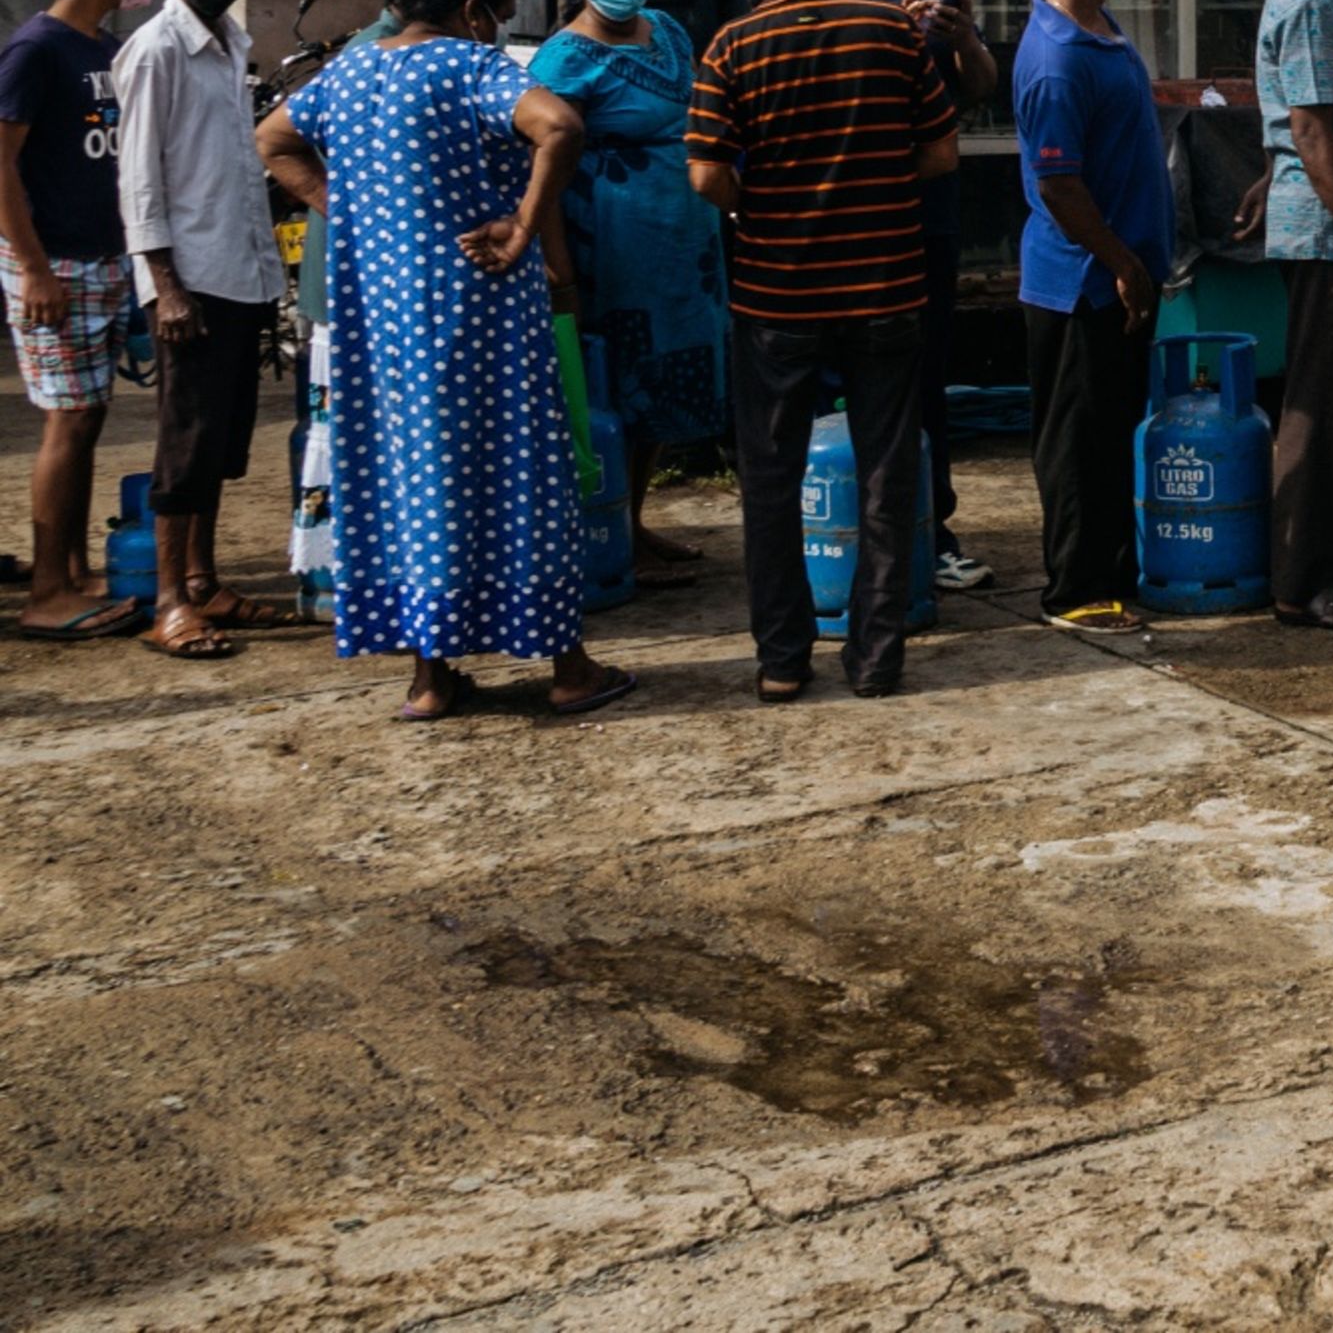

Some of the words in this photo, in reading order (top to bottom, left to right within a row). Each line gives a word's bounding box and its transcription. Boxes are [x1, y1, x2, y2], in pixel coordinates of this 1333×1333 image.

[1160, 468, 1205, 483] LITRO
[1166, 482, 1200, 496] GAS
[822, 544, 843, 559] kg
